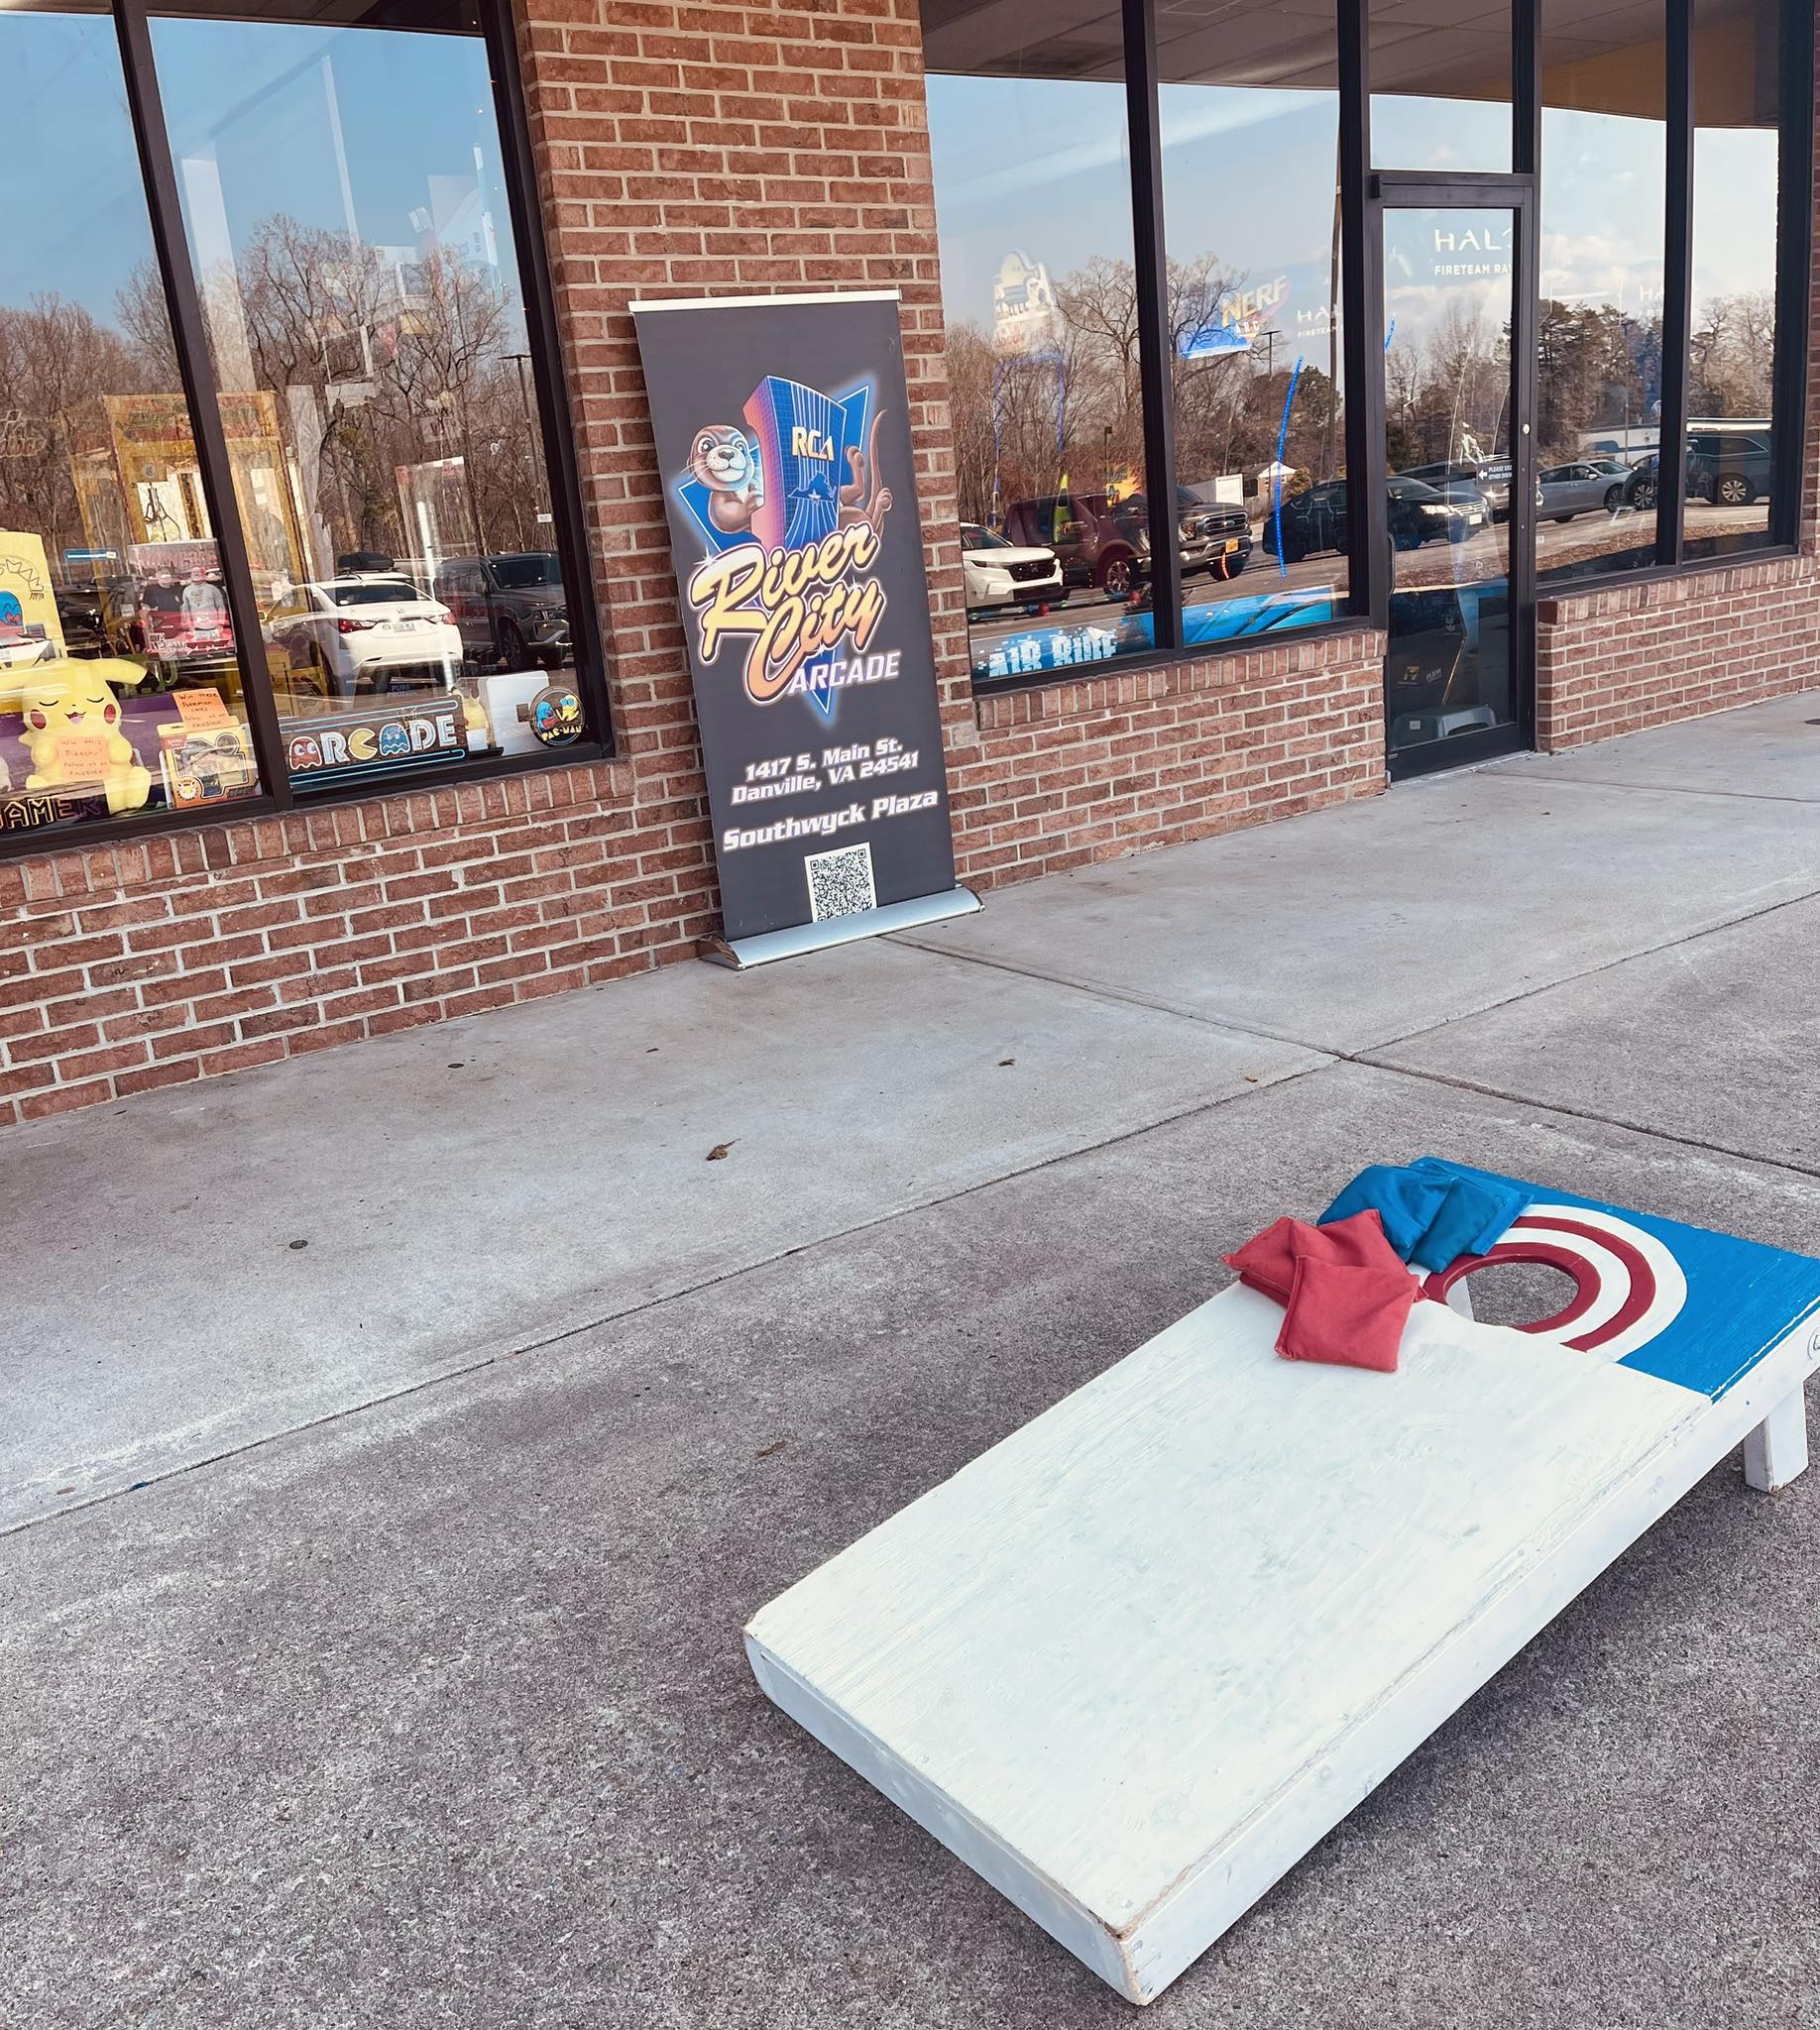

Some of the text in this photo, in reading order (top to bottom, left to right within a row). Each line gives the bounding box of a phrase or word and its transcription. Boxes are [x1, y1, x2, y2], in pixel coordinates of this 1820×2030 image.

[1434, 263, 1490, 277] FIRETEAM
[1221, 275, 1288, 329] NERF
[792, 426, 835, 461] RCA
[690, 521, 881, 664] River
[746, 579, 886, 702] City
[788, 650, 902, 695] ARCADE
[288, 714, 458, 770] ARCADE
[540, 725, 584, 742] PAC-MAN
[731, 750, 919, 806] Danville, VA 24541
[745, 737, 903, 782] 1417 S. Main St.
[0, 796, 101, 831] AMER
[723, 791, 939, 852] Southwyck Plaza
